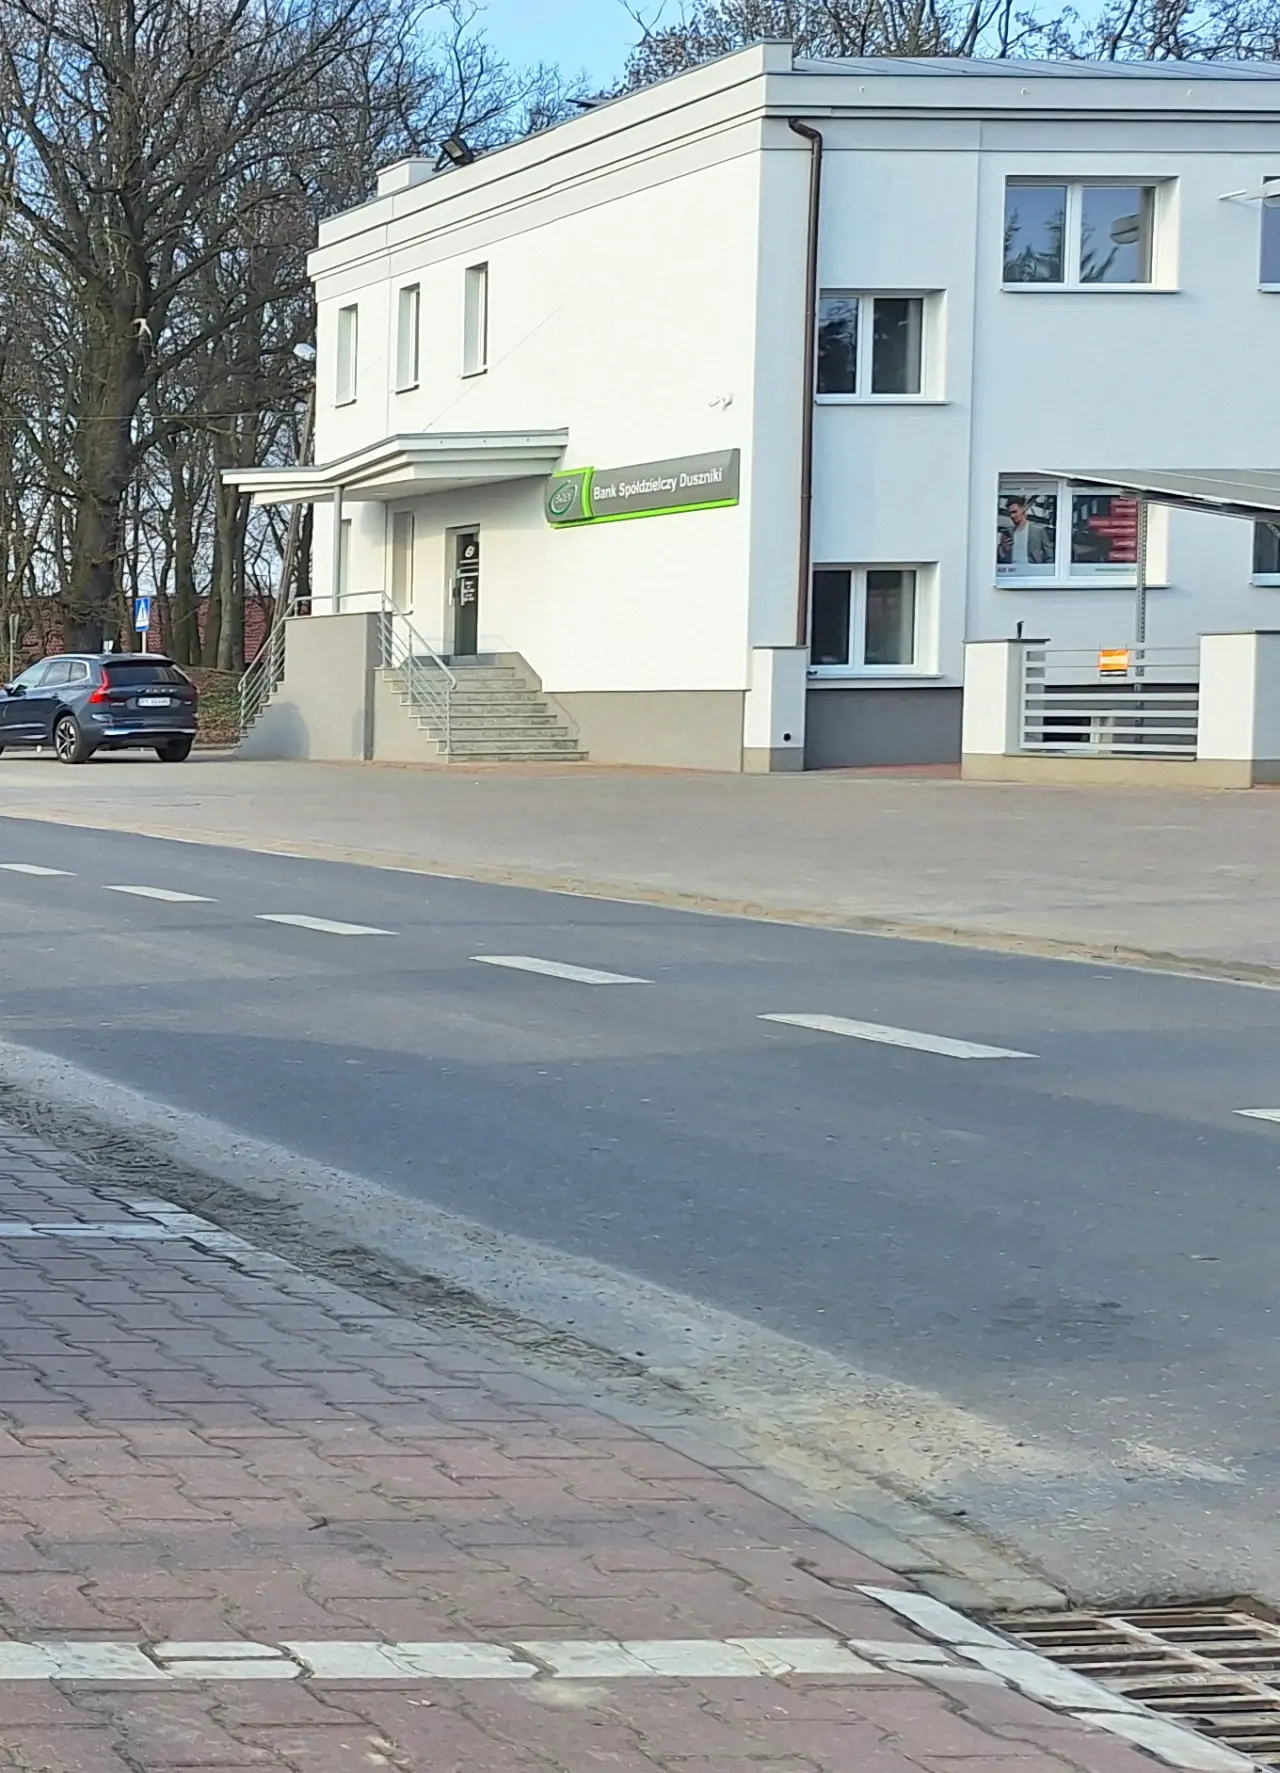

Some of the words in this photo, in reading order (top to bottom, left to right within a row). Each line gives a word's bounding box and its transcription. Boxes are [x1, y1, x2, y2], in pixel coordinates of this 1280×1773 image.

[593, 484, 617, 500] Bank
[619, 477, 677, 499] Spółdzielczy
[680, 468, 723, 488] Duszniki
